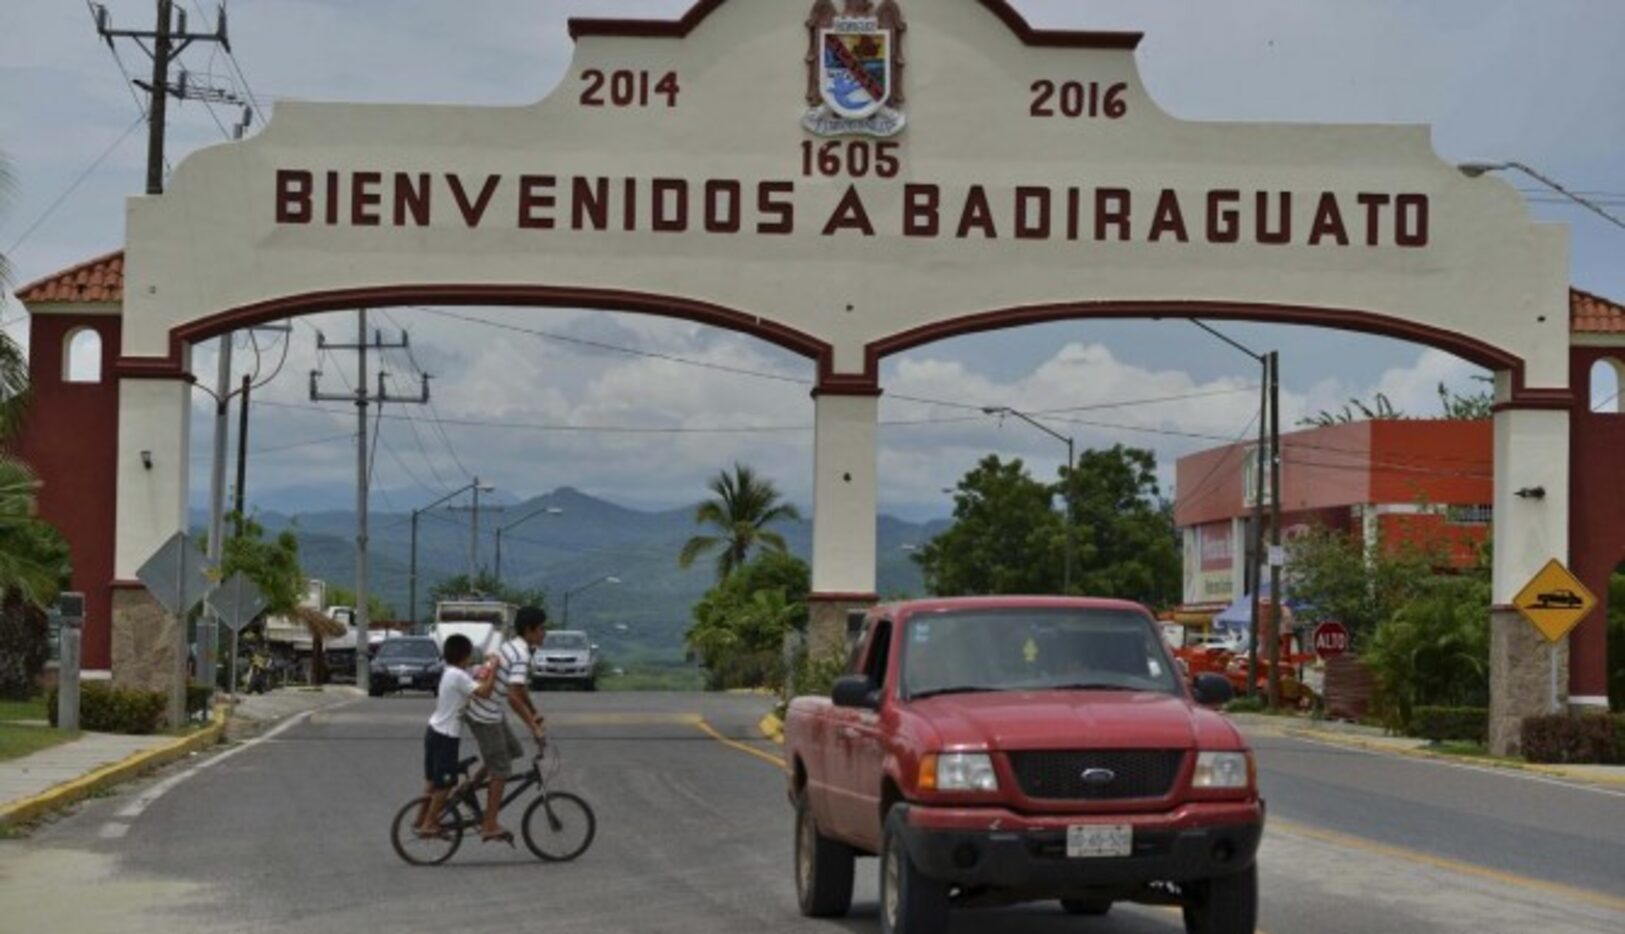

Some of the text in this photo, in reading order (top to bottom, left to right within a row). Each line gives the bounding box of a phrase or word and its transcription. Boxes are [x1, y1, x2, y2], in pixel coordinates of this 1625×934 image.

[579, 68, 681, 108] 2014
[1029, 79, 1129, 120] 2016
[801, 139, 901, 179] 1605
[275, 168, 1431, 249] BIENVENIDOS A BADIRAGUATO
[1317, 632, 1346, 650] ALTO
